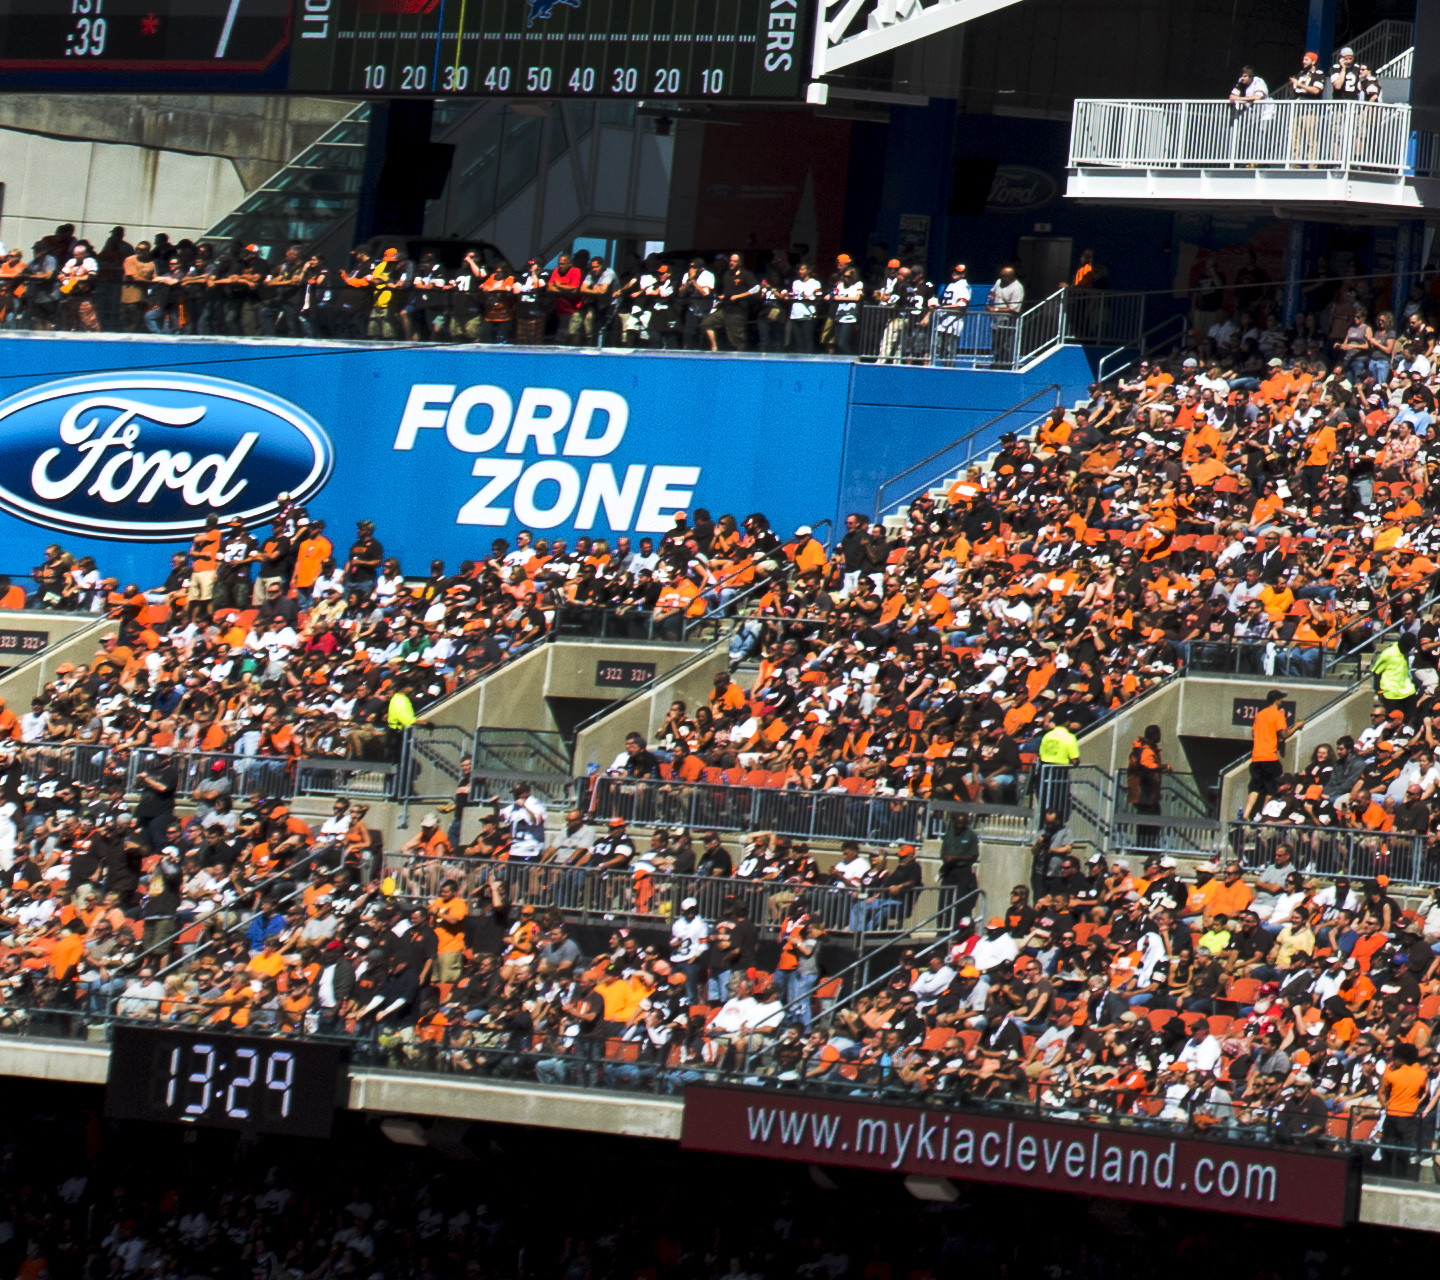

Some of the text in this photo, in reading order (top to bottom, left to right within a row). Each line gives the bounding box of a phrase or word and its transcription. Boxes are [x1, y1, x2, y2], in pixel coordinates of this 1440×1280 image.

[364, 65, 386, 90] 10
[401, 65, 427, 90] 20
[443, 65, 468, 91] 30
[484, 66, 511, 91] 40
[526, 66, 552, 91] 50
[568, 67, 595, 92] 40
[611, 67, 638, 92] 30
[653, 68, 680, 93] 20
[701, 68, 723, 94] 10
[394, 383, 630, 457] FORD
[31, 396, 260, 507] Ford
[457, 458, 701, 535] ZONE
[605, 668, 622, 680] 322
[630, 669, 646, 681] 321
[166, 1043, 294, 1120] 13:29
[747, 1106, 1278, 1203] www.mykiacleveland.com
